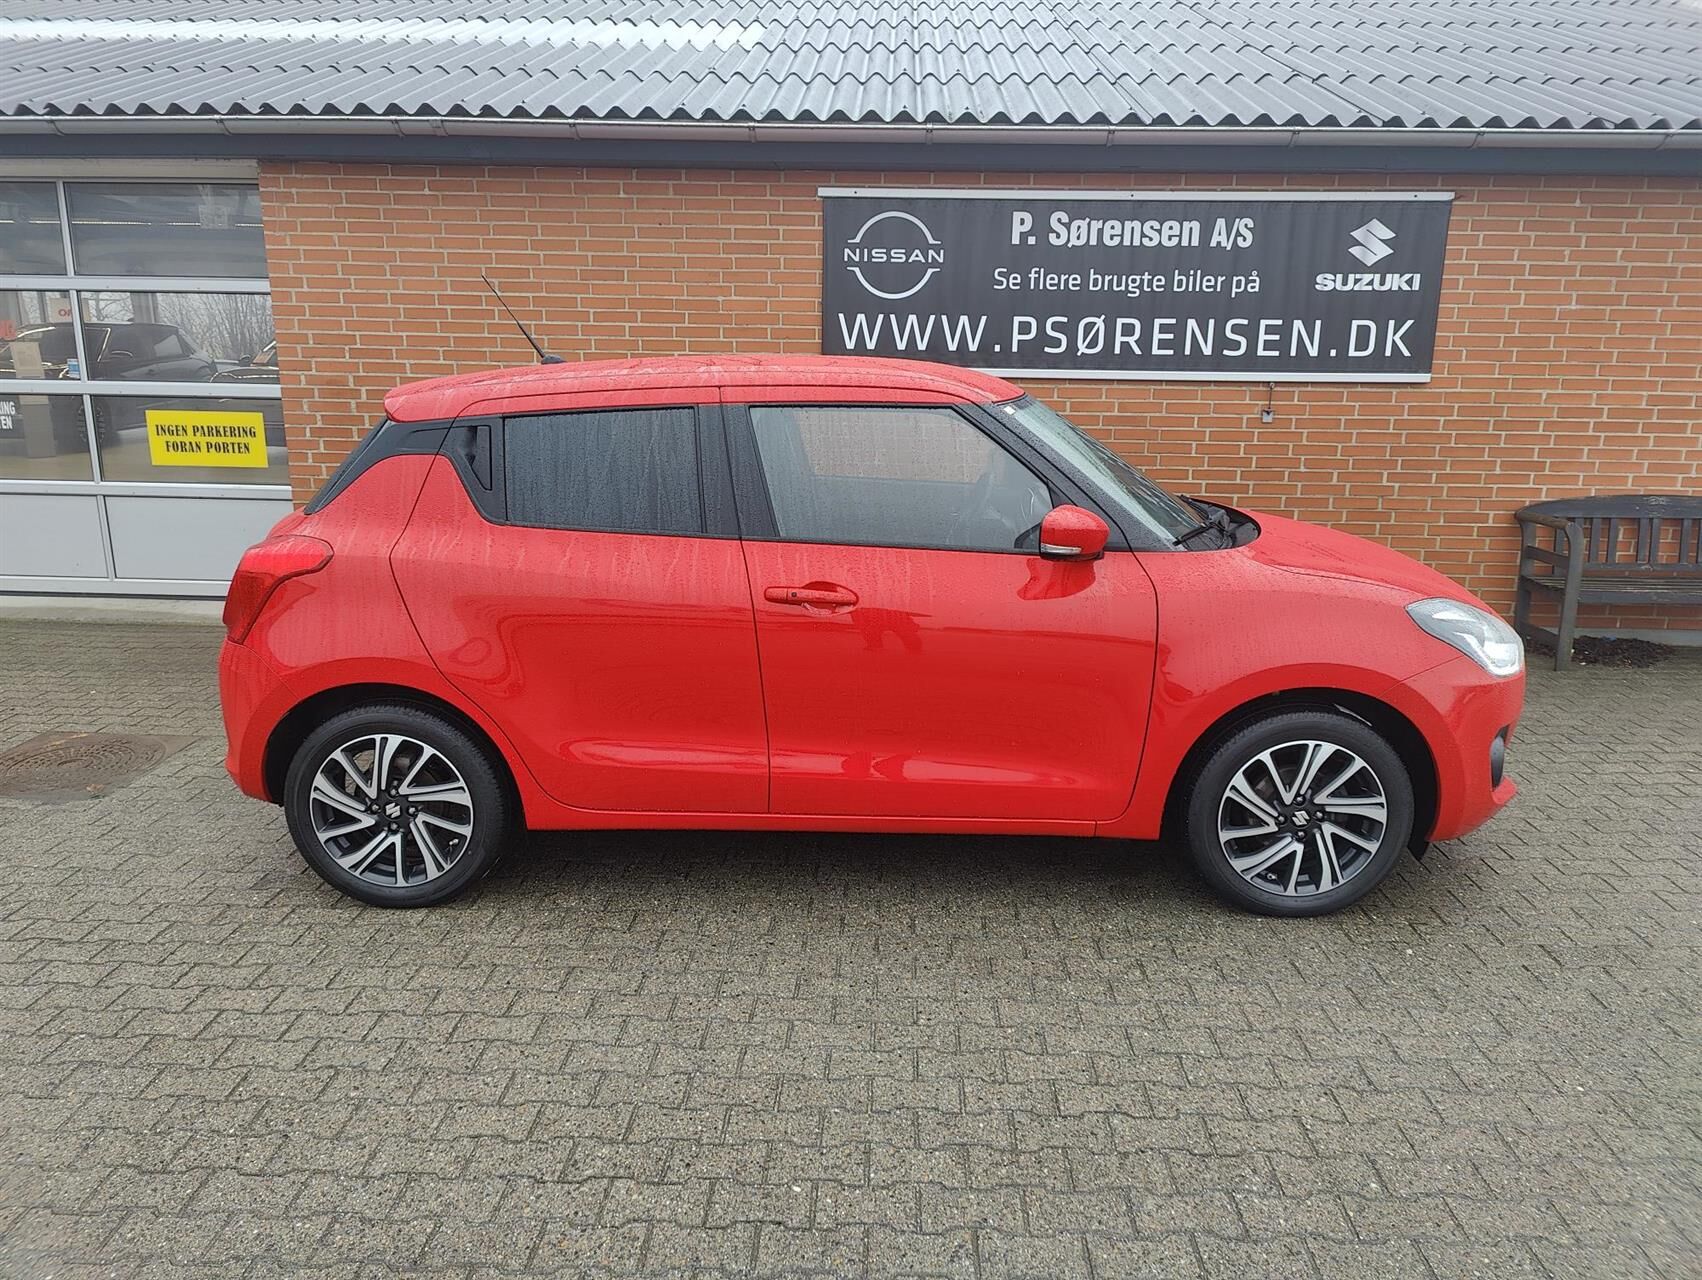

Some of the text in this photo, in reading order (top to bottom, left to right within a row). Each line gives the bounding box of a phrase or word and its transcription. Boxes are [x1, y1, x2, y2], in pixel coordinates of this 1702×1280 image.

[1011, 211, 1255, 250] P. Sørensen A/S
[843, 247, 944, 264] NISSAN
[993, 267, 1261, 298] Se flere brugte biler på
[1315, 273, 1420, 291] SUZUKI
[838, 312, 1415, 358] WWW.PSØRENSEN.DK
[0, 400, 16, 415] ING
[155, 424, 257, 438] INGEN PARKERING
[165, 441, 251, 454] FORAN PORTEN
